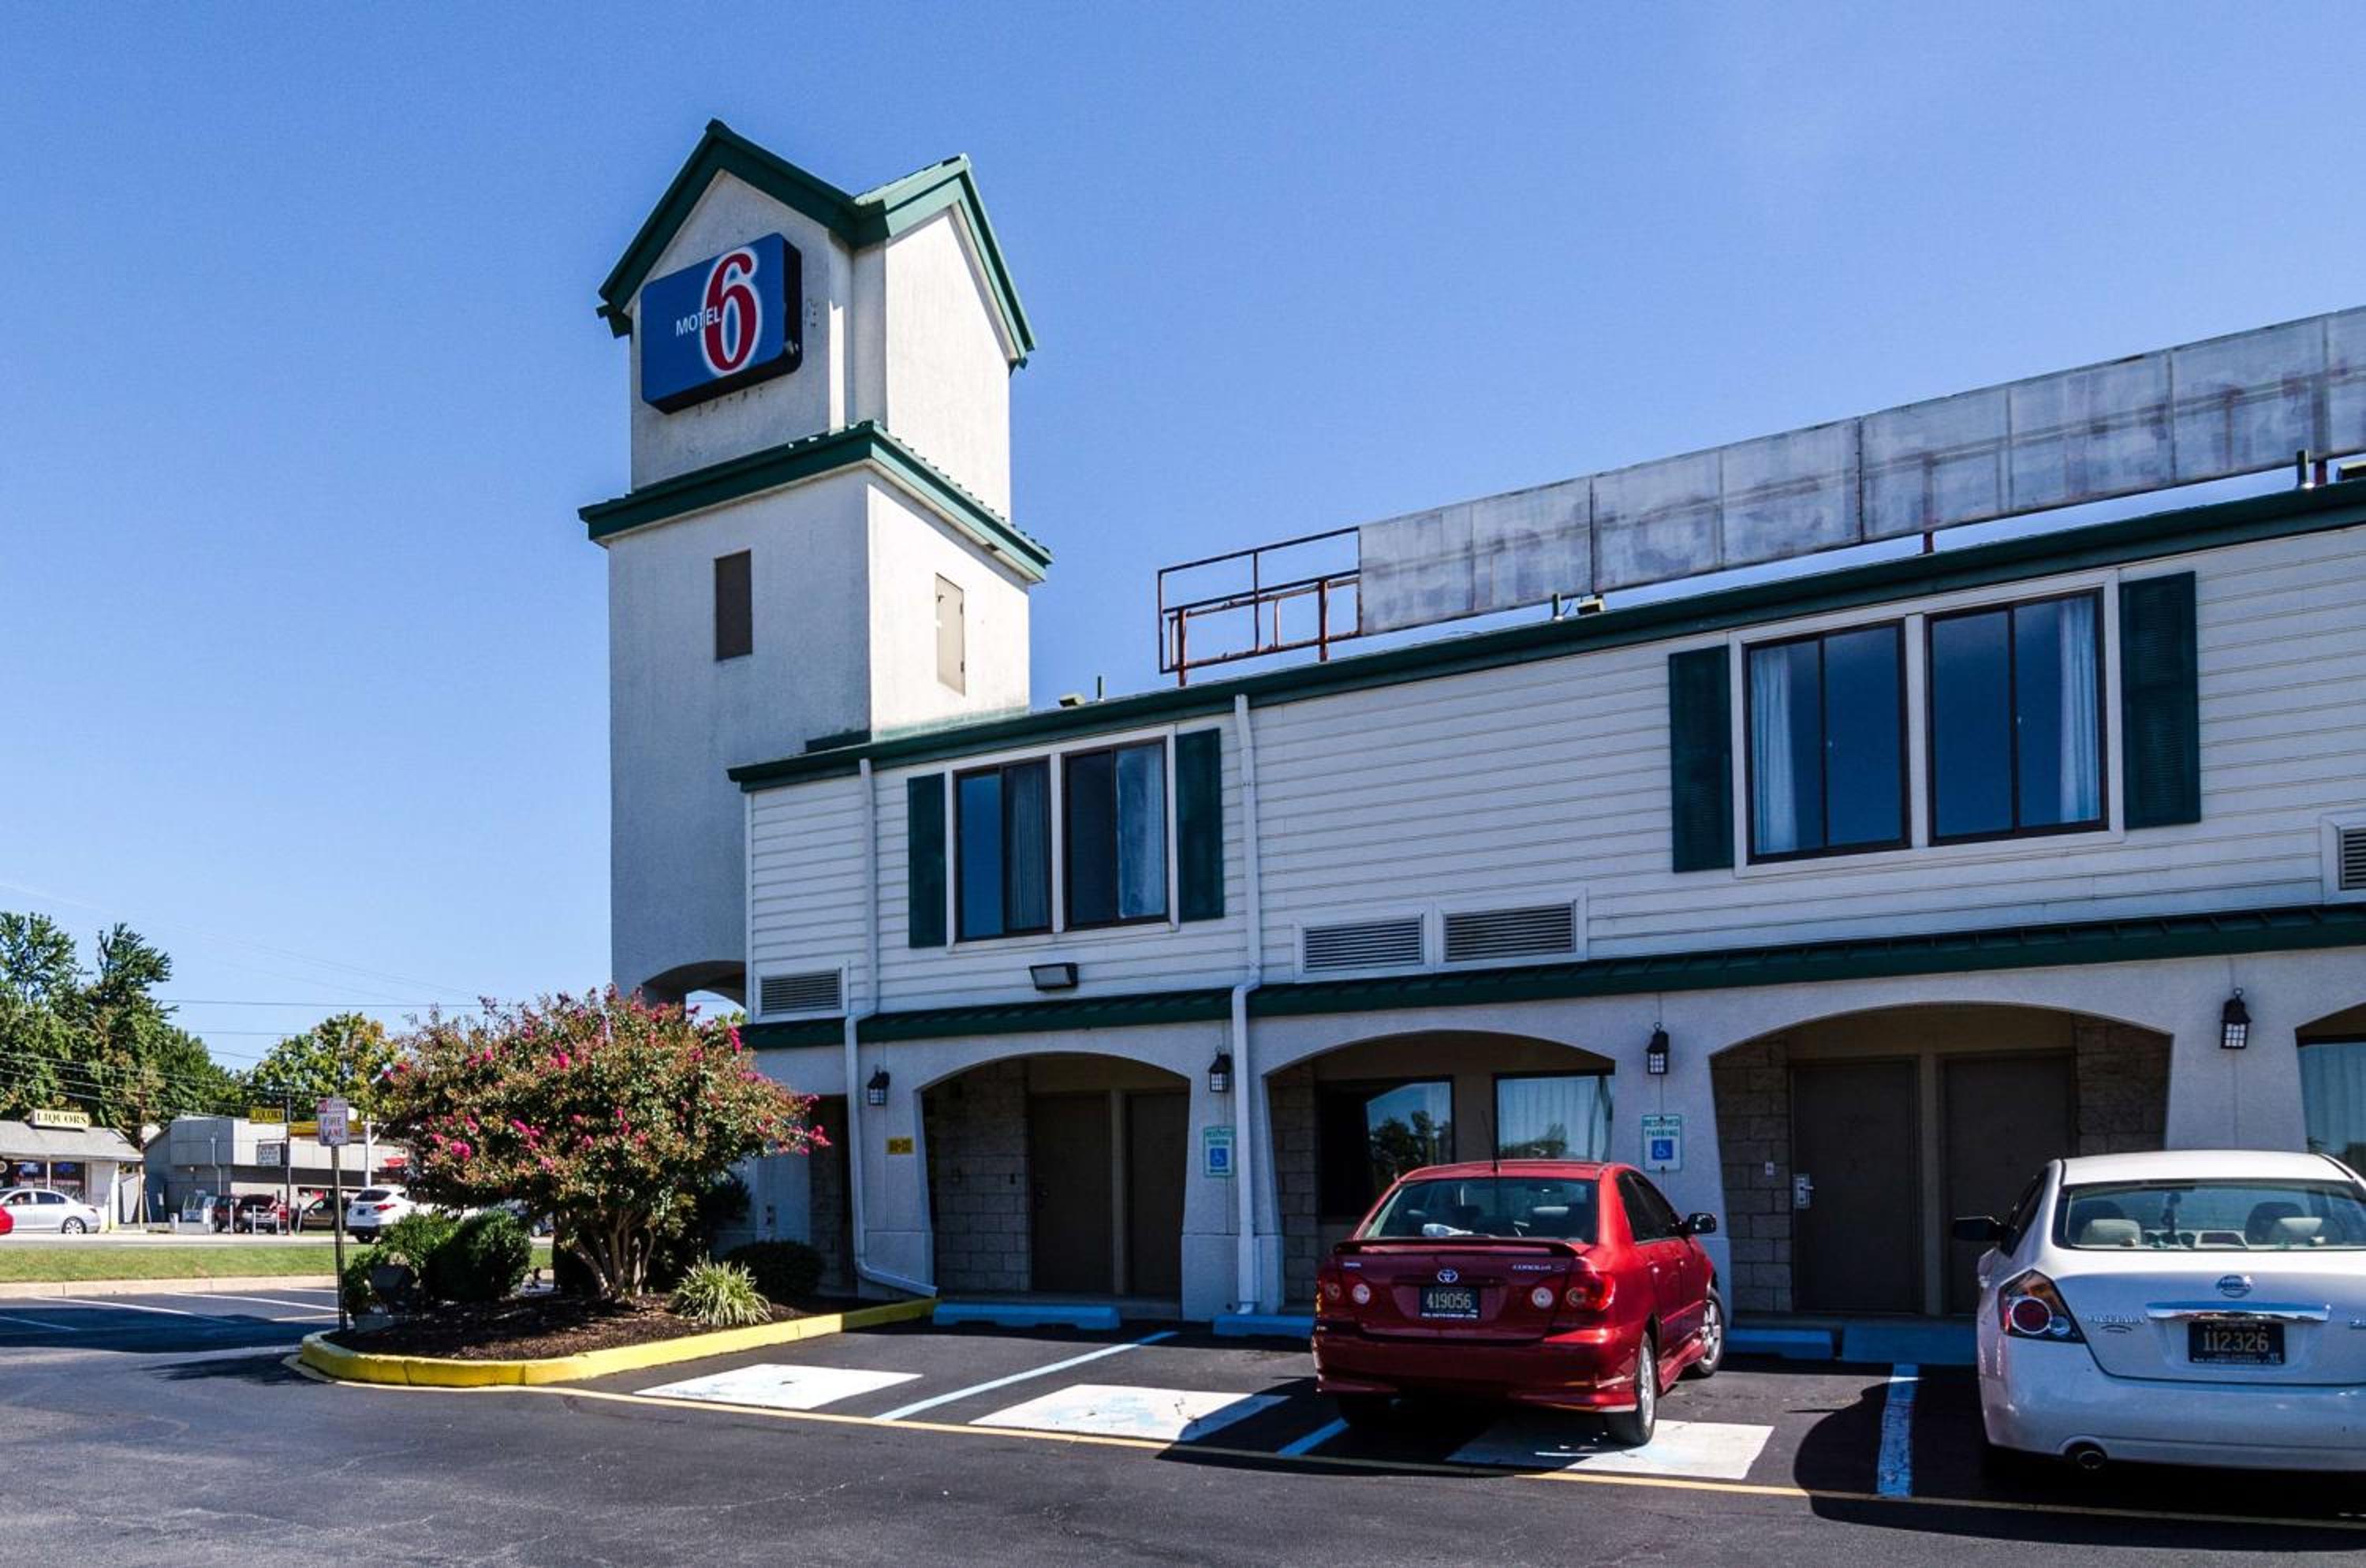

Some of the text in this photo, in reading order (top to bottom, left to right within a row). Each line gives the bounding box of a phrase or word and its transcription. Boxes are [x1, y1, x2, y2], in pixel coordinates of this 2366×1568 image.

[676, 247, 762, 377] MOTEL 6
[37, 1113, 86, 1124] LIQUORS
[1427, 1292, 1472, 1309] 419056
[2204, 1331, 2269, 1352] 112326
